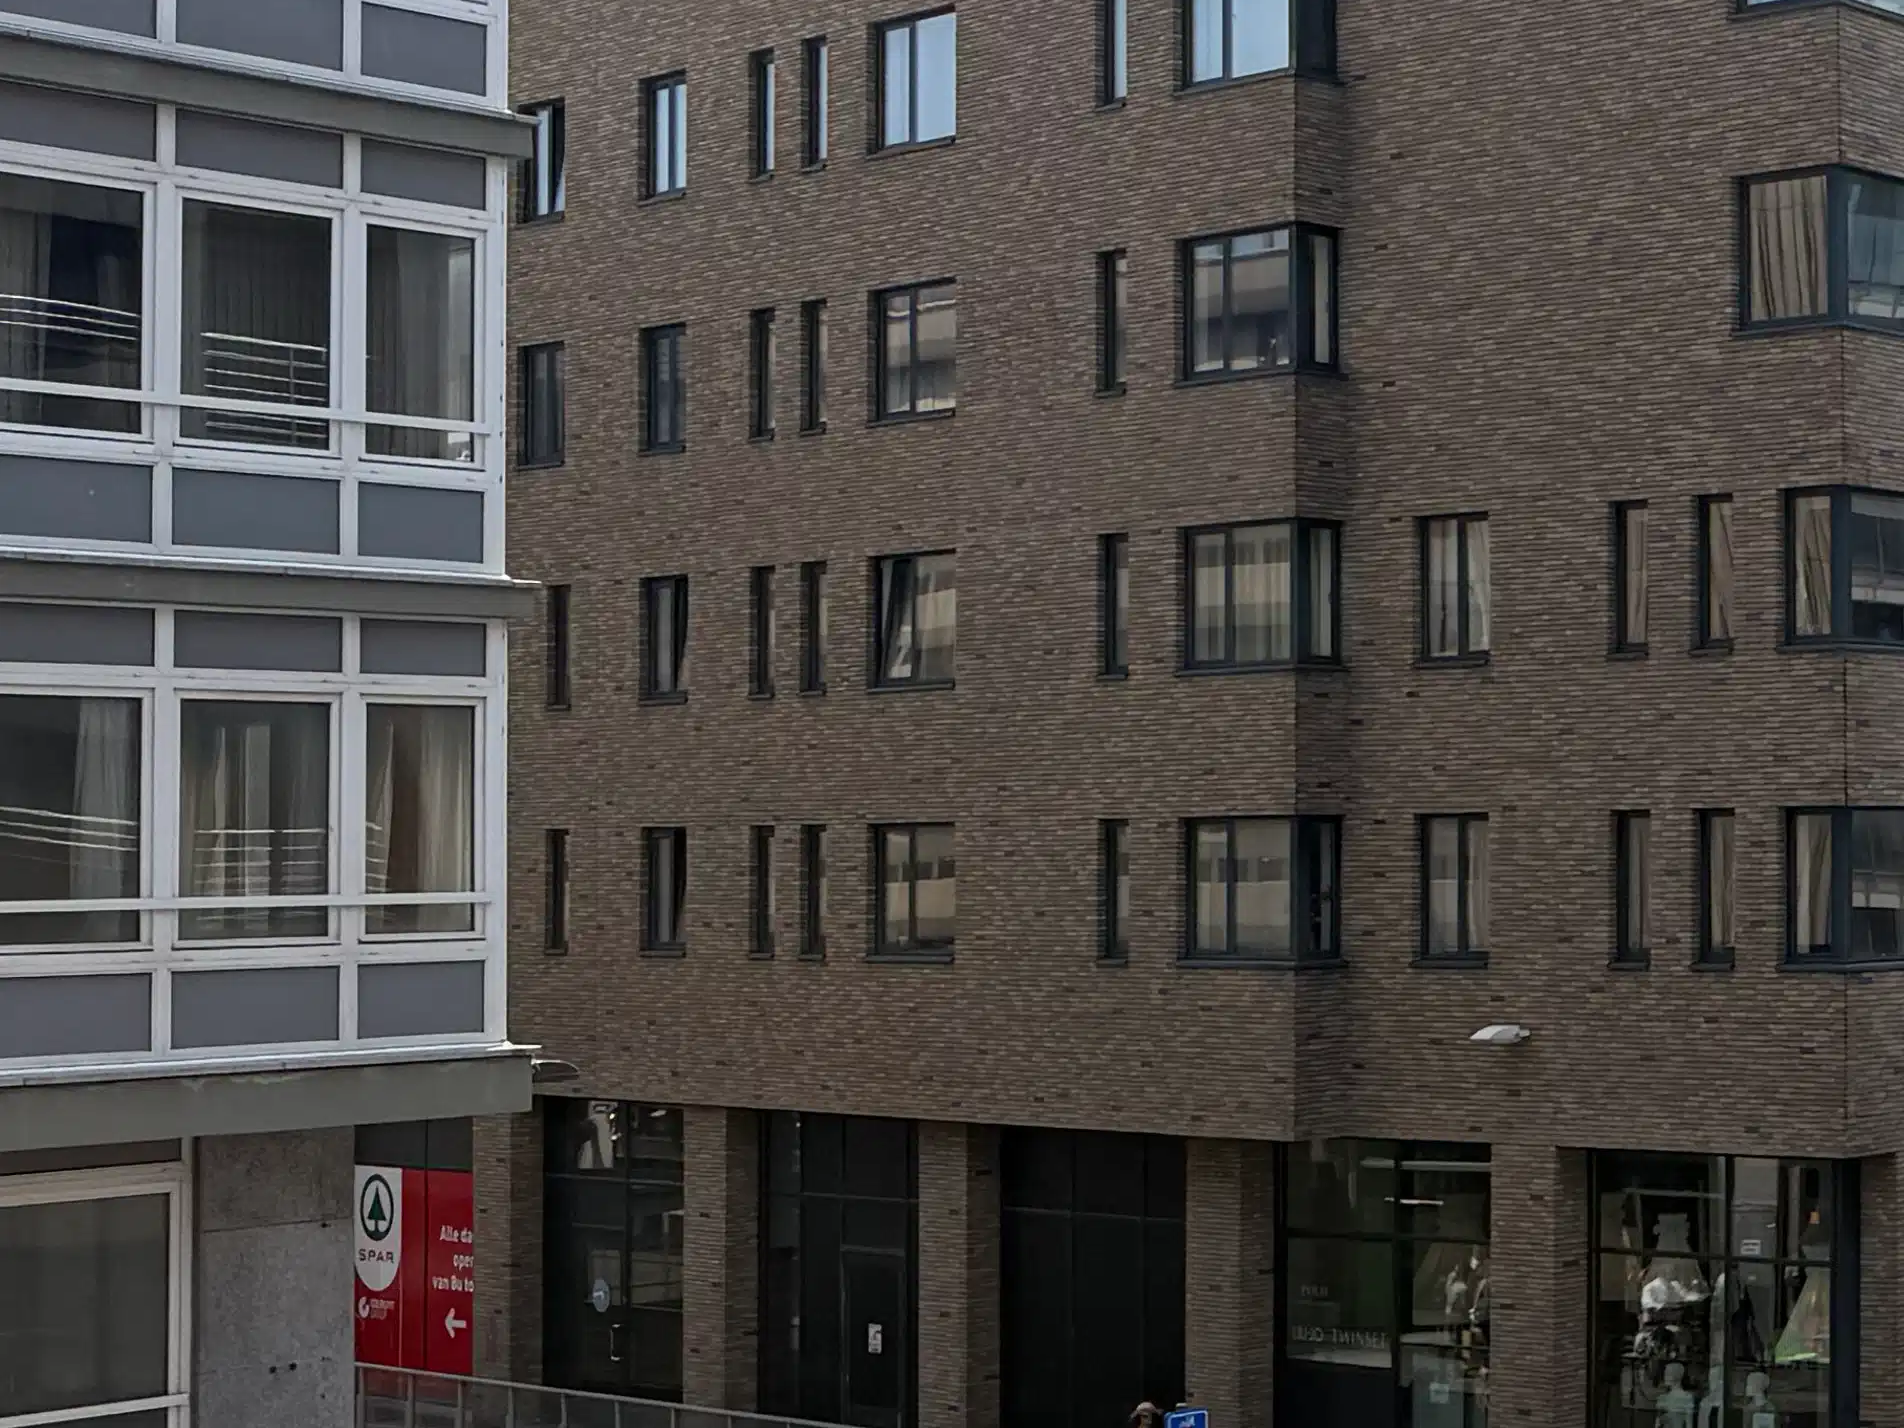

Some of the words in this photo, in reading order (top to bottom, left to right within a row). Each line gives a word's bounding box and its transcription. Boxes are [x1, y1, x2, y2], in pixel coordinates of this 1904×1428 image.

[439, 1225, 459, 1242] Alle
[460, 1227, 473, 1244] da
[358, 1248, 394, 1263] SPAR
[464, 1277, 474, 1292] to
